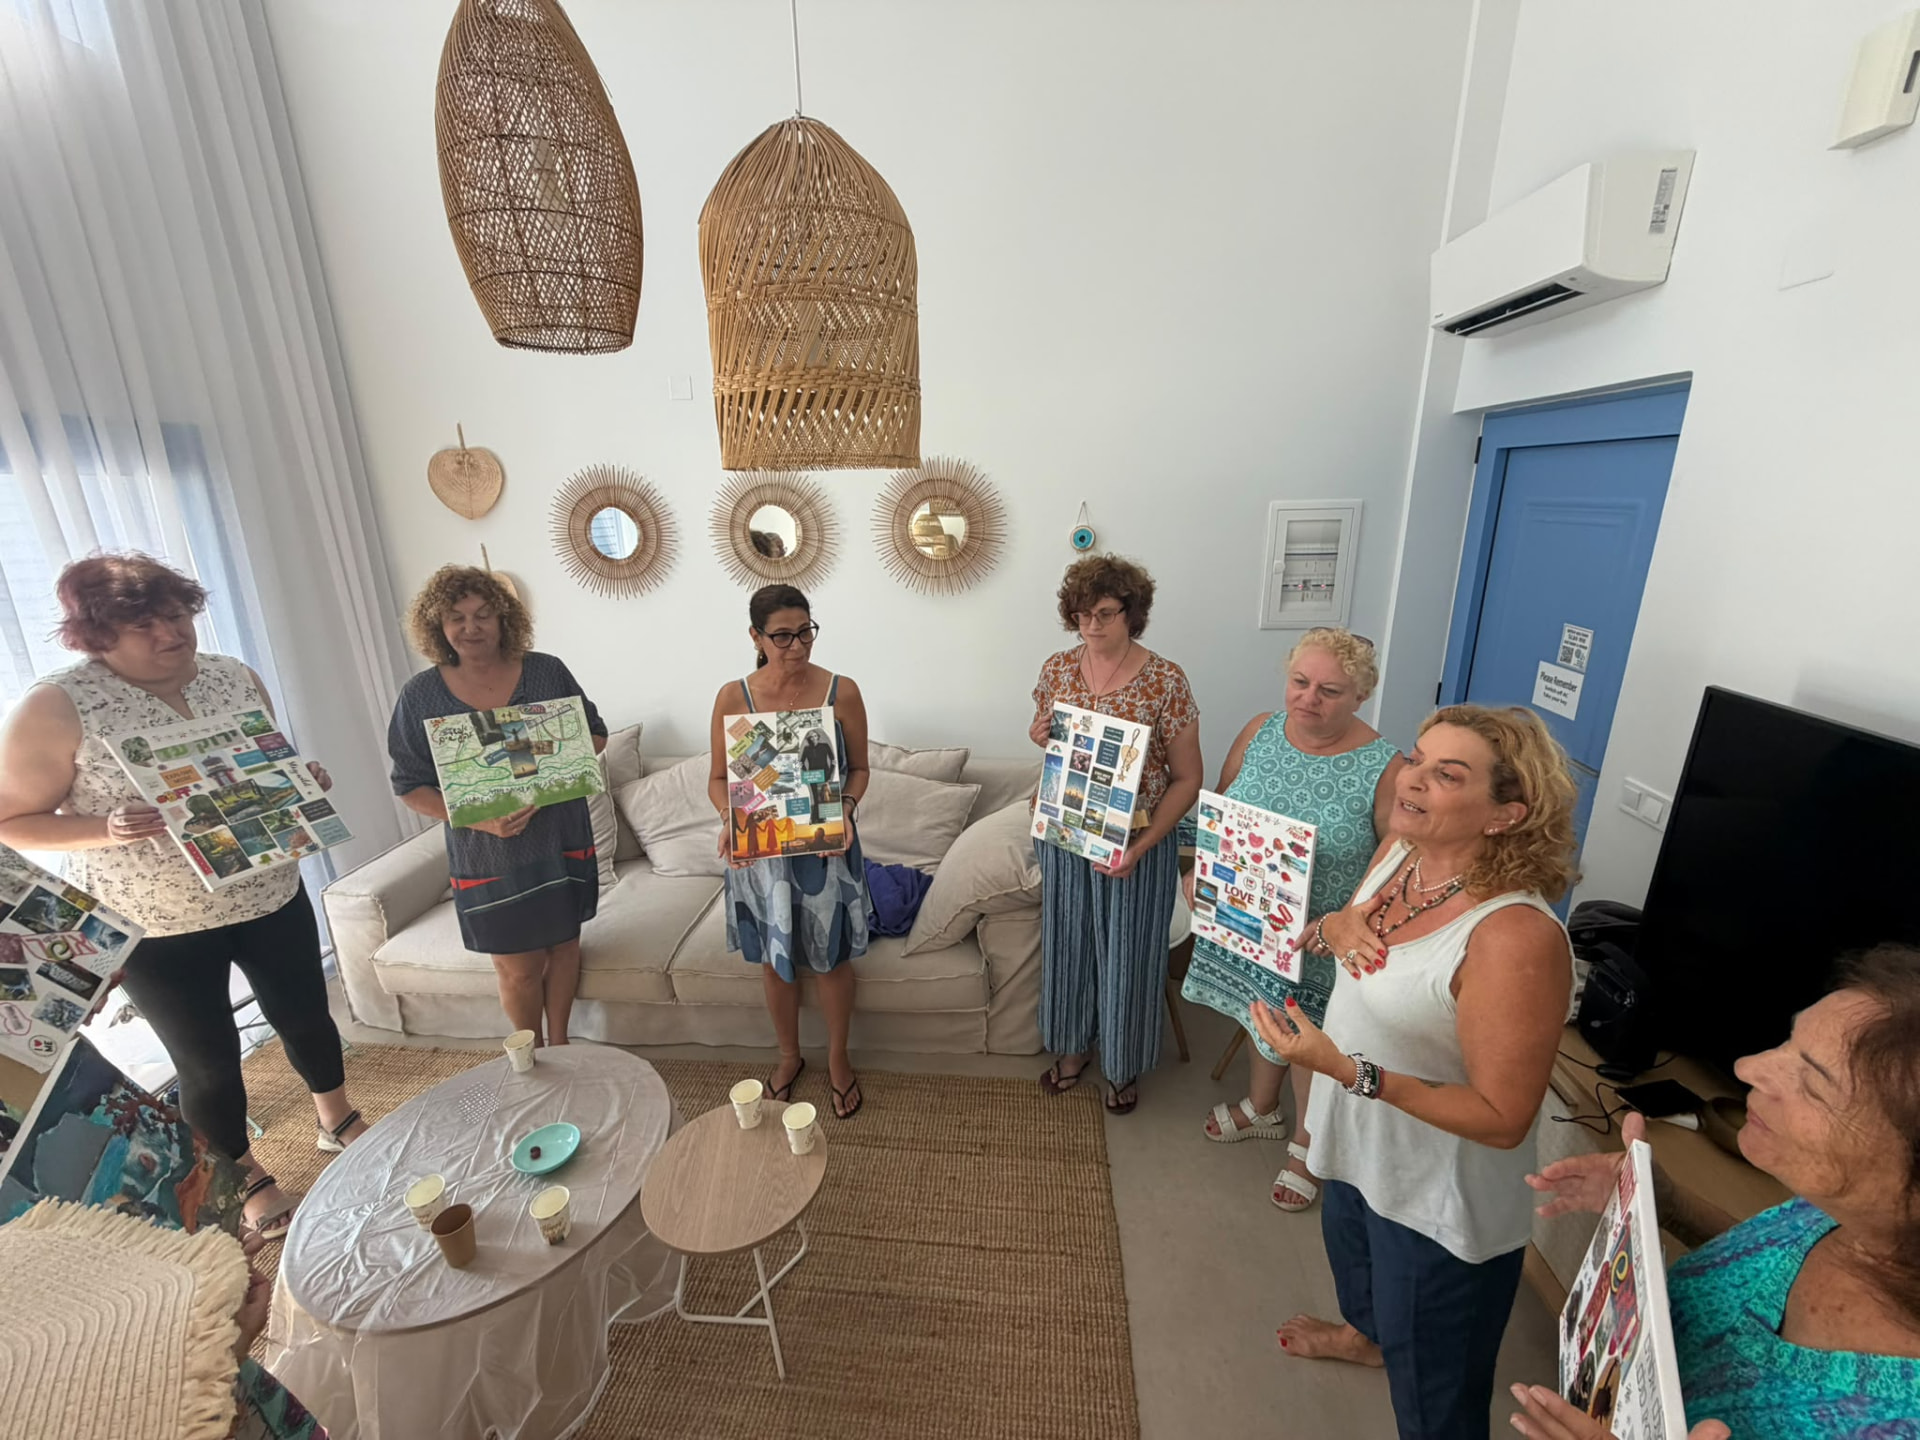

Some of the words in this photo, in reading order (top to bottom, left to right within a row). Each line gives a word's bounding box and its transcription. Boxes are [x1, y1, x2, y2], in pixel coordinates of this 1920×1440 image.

[1540, 671, 1554, 684] Please
[1554, 676, 1578, 692] Remember
[1224, 883, 1255, 906] LOVE
[43, 1040, 54, 1053] ME
